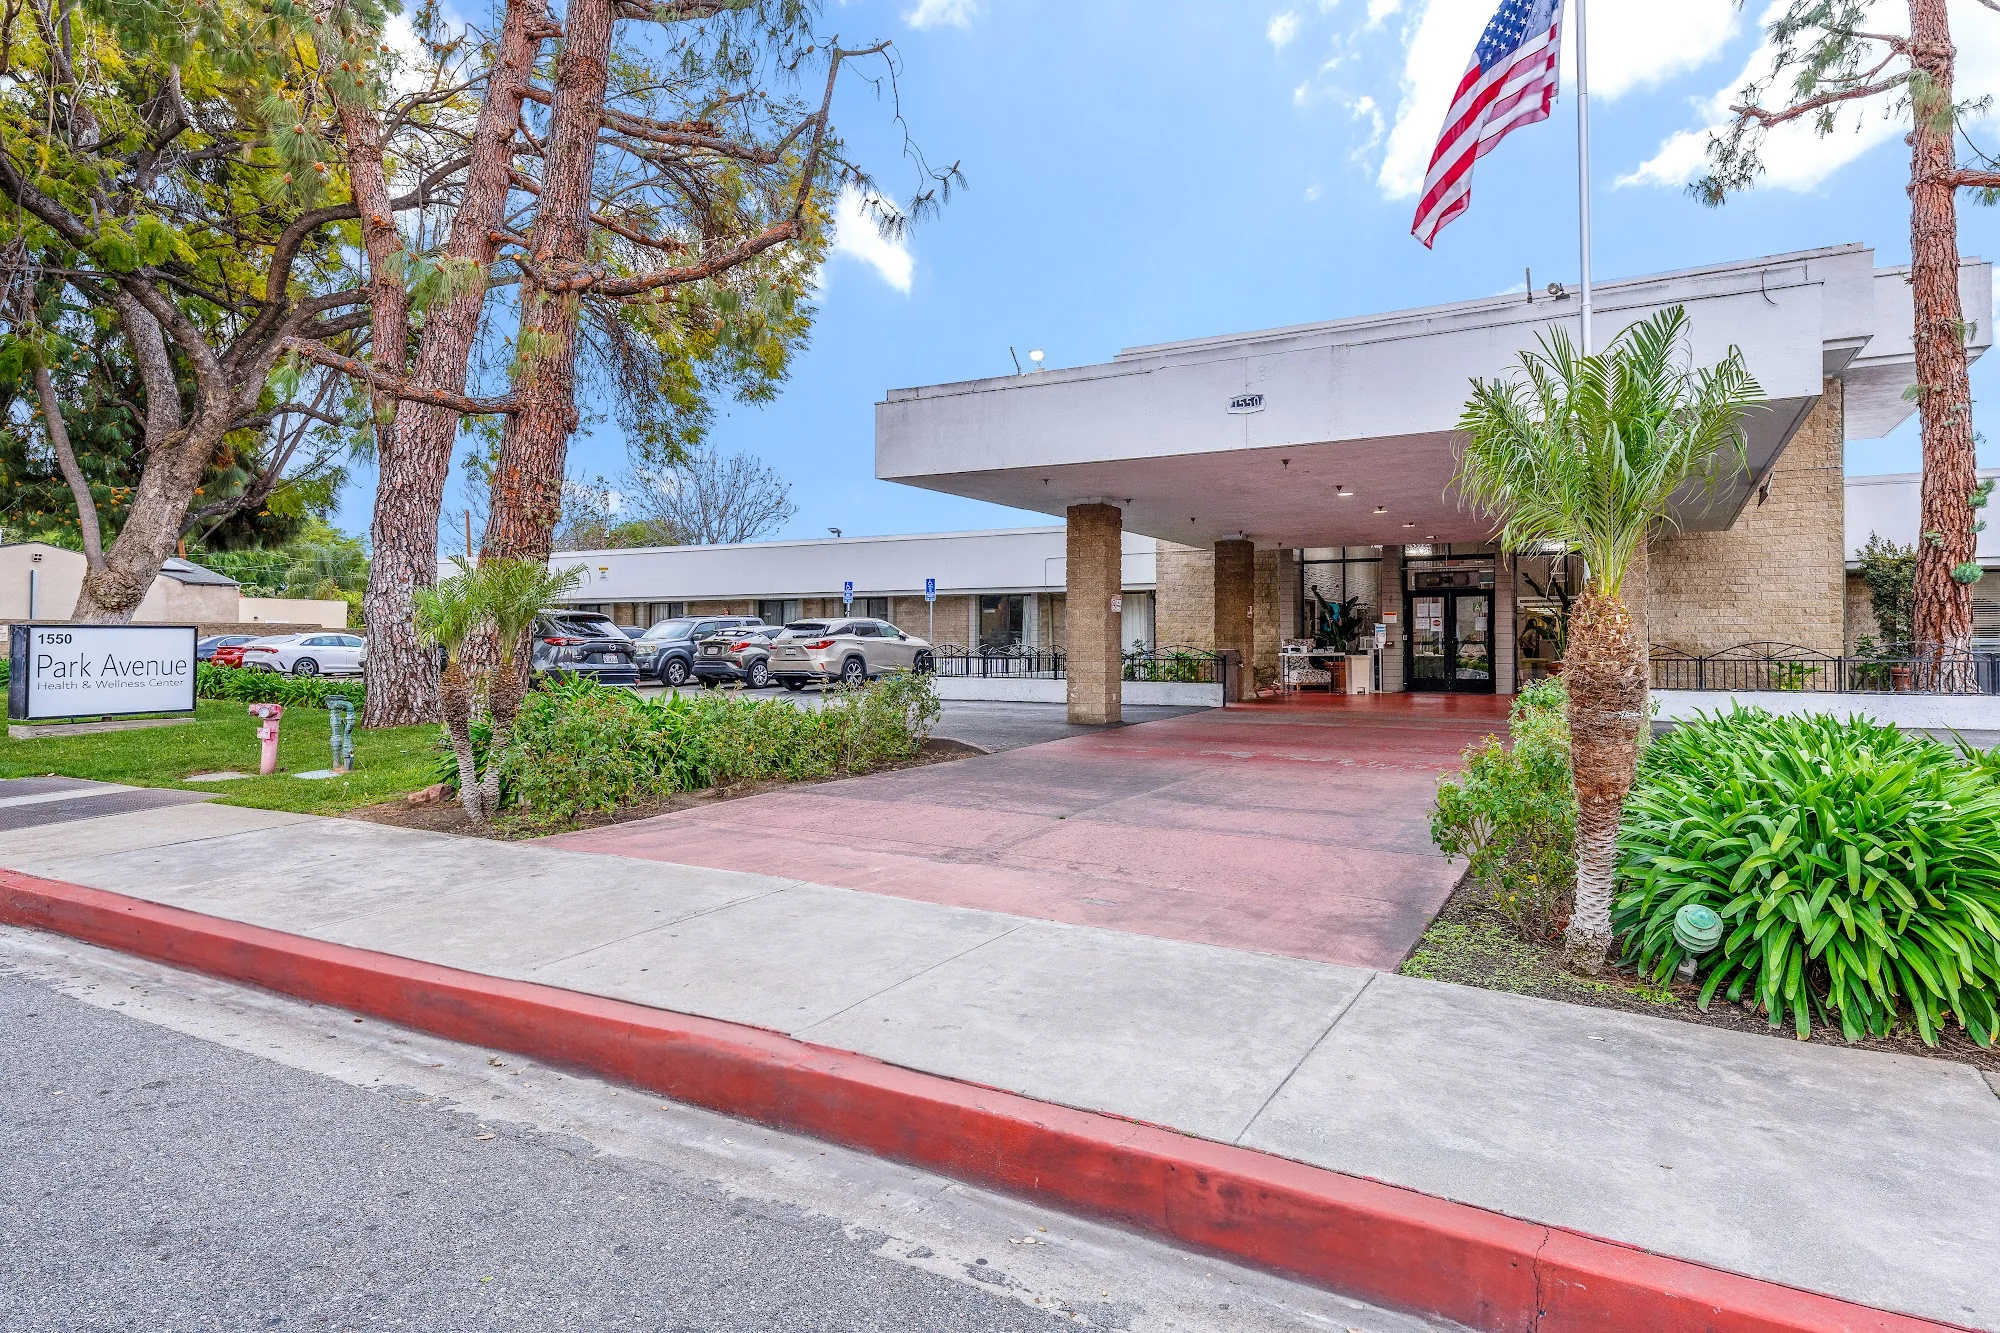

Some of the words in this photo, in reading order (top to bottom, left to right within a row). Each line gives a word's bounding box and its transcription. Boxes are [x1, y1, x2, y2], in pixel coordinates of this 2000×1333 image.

[1234, 397, 1260, 409] 1550
[37, 633, 72, 645] 1550
[37, 652, 92, 678] Park
[100, 653, 187, 677] Avenue
[37, 681, 78, 690] Health
[82, 680, 92, 689] &
[95, 679, 146, 689] Wellness
[148, 678, 184, 687] Center
